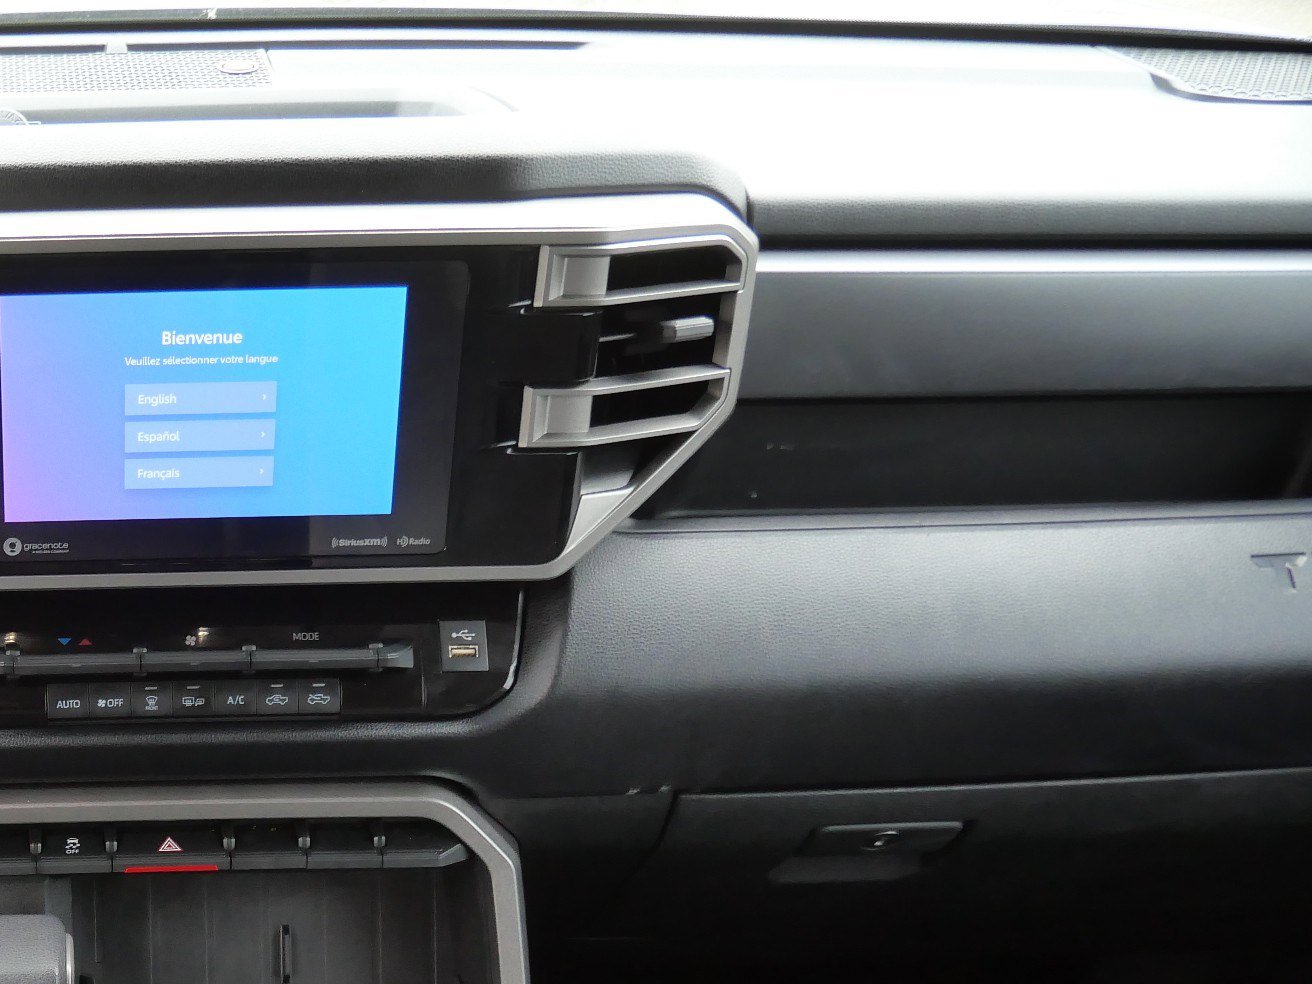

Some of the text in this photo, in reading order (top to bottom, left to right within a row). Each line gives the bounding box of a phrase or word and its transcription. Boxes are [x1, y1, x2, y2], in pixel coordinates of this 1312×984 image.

[161, 331, 243, 345] Bienvenue
[124, 354, 279, 366] Veuillez sélectionner votre langue
[137, 394, 177, 407] English
[137, 431, 180, 444] Español
[137, 468, 180, 480] Français
[23, 541, 69, 552] gracenote
[409, 537, 431, 546] Radio
[292, 632, 320, 642] MODE
[56, 699, 81, 709] AUTO
[107, 698, 124, 708] OFF
[227, 695, 245, 705] A/C
